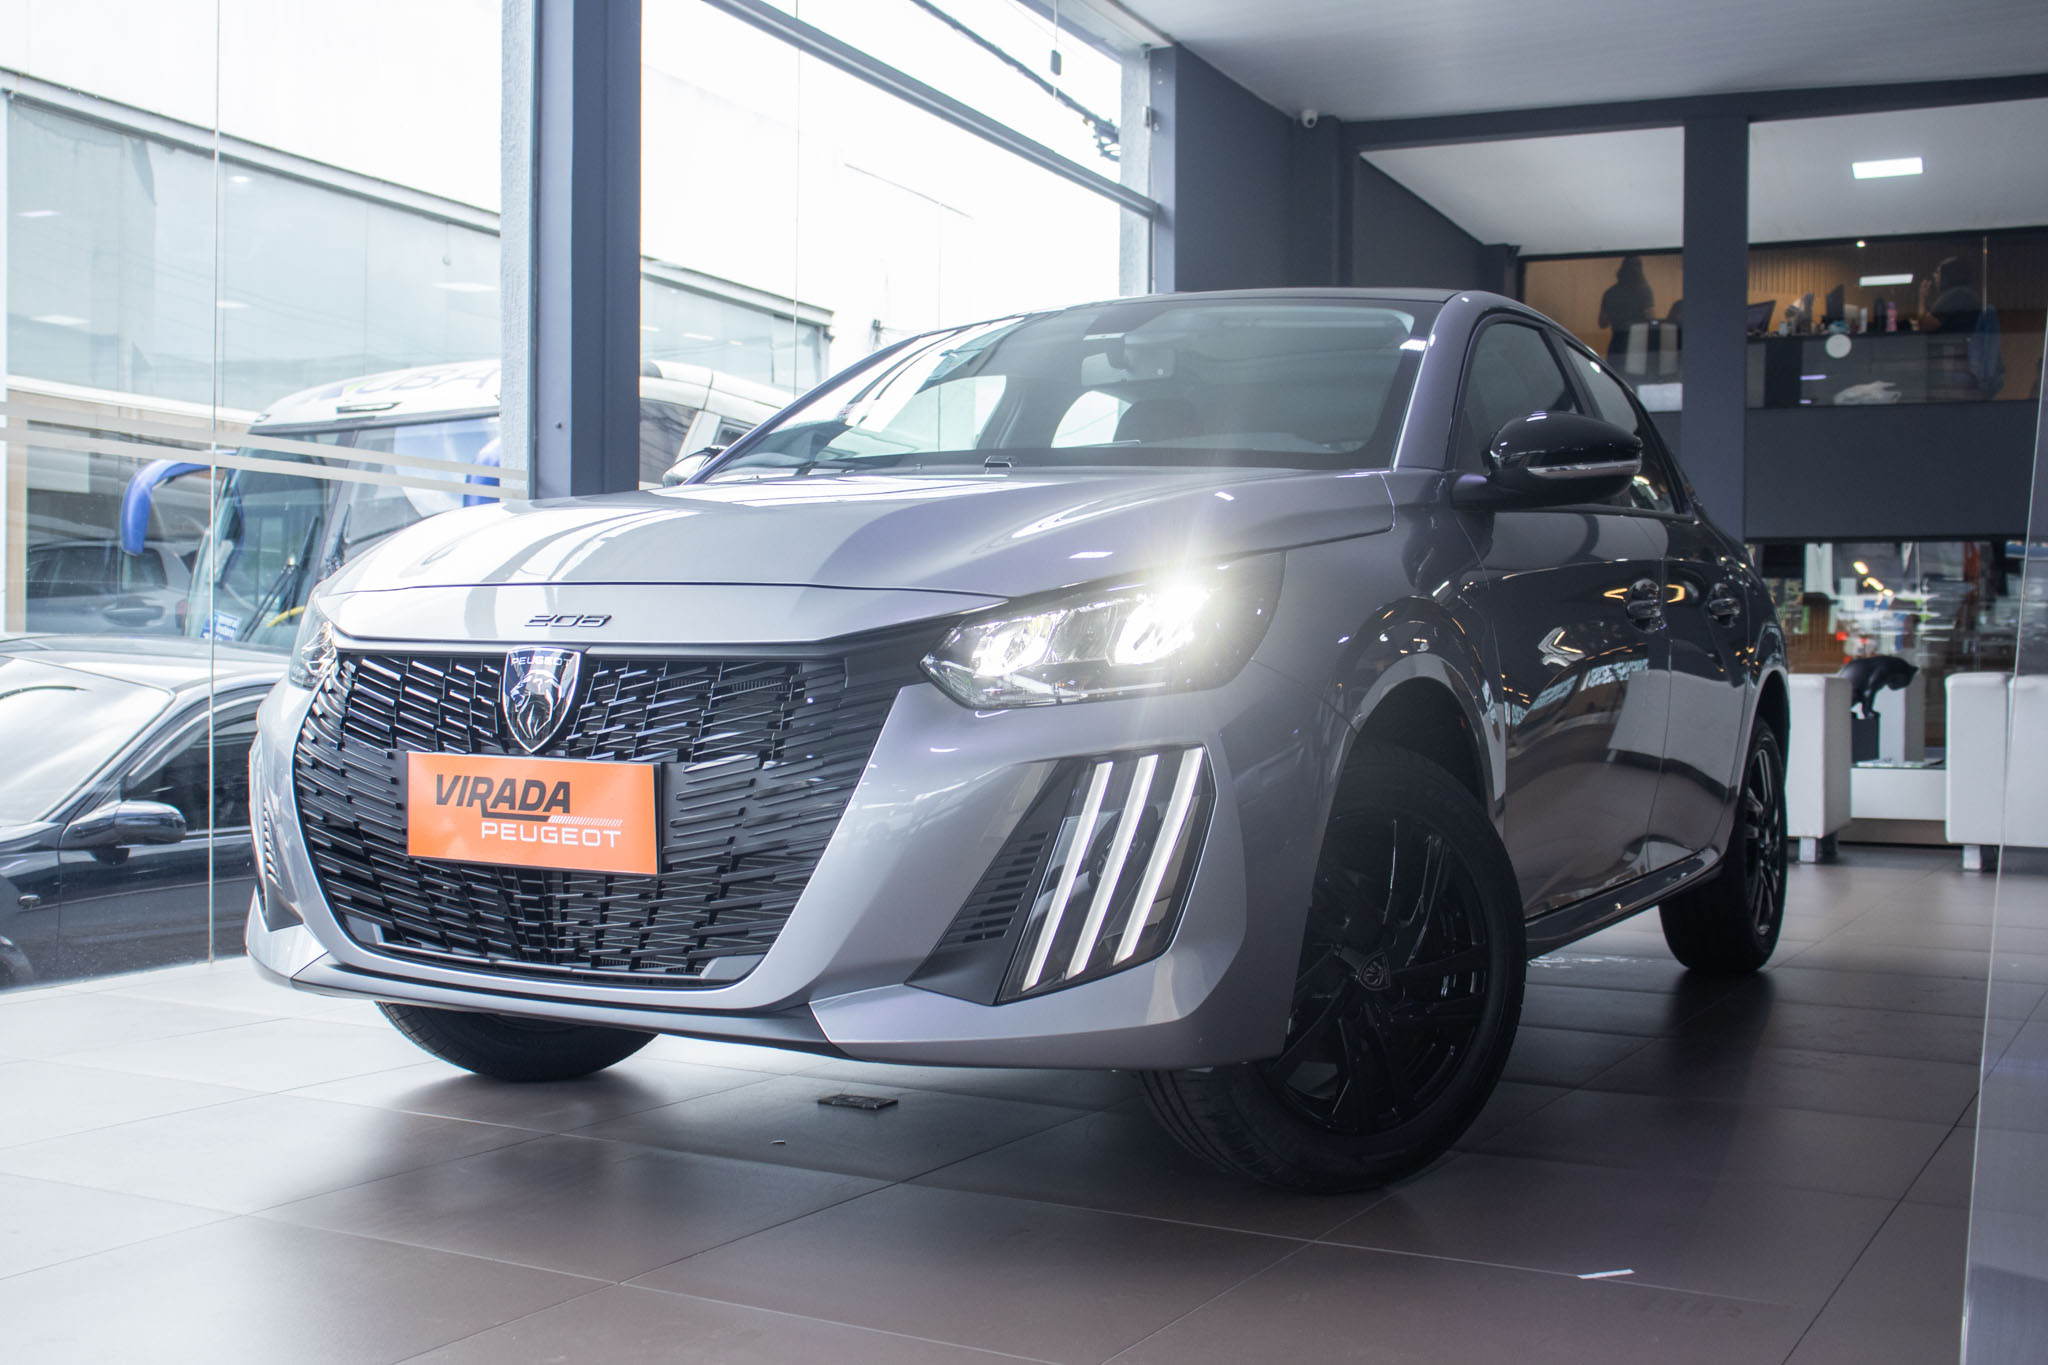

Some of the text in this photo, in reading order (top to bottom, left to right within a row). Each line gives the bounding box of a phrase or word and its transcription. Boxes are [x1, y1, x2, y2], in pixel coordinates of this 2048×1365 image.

[524, 614, 612, 628] 208
[510, 655, 572, 666] PEUGEOT
[435, 774, 571, 822] VIRADA
[481, 821, 622, 847] PEUGEOT
